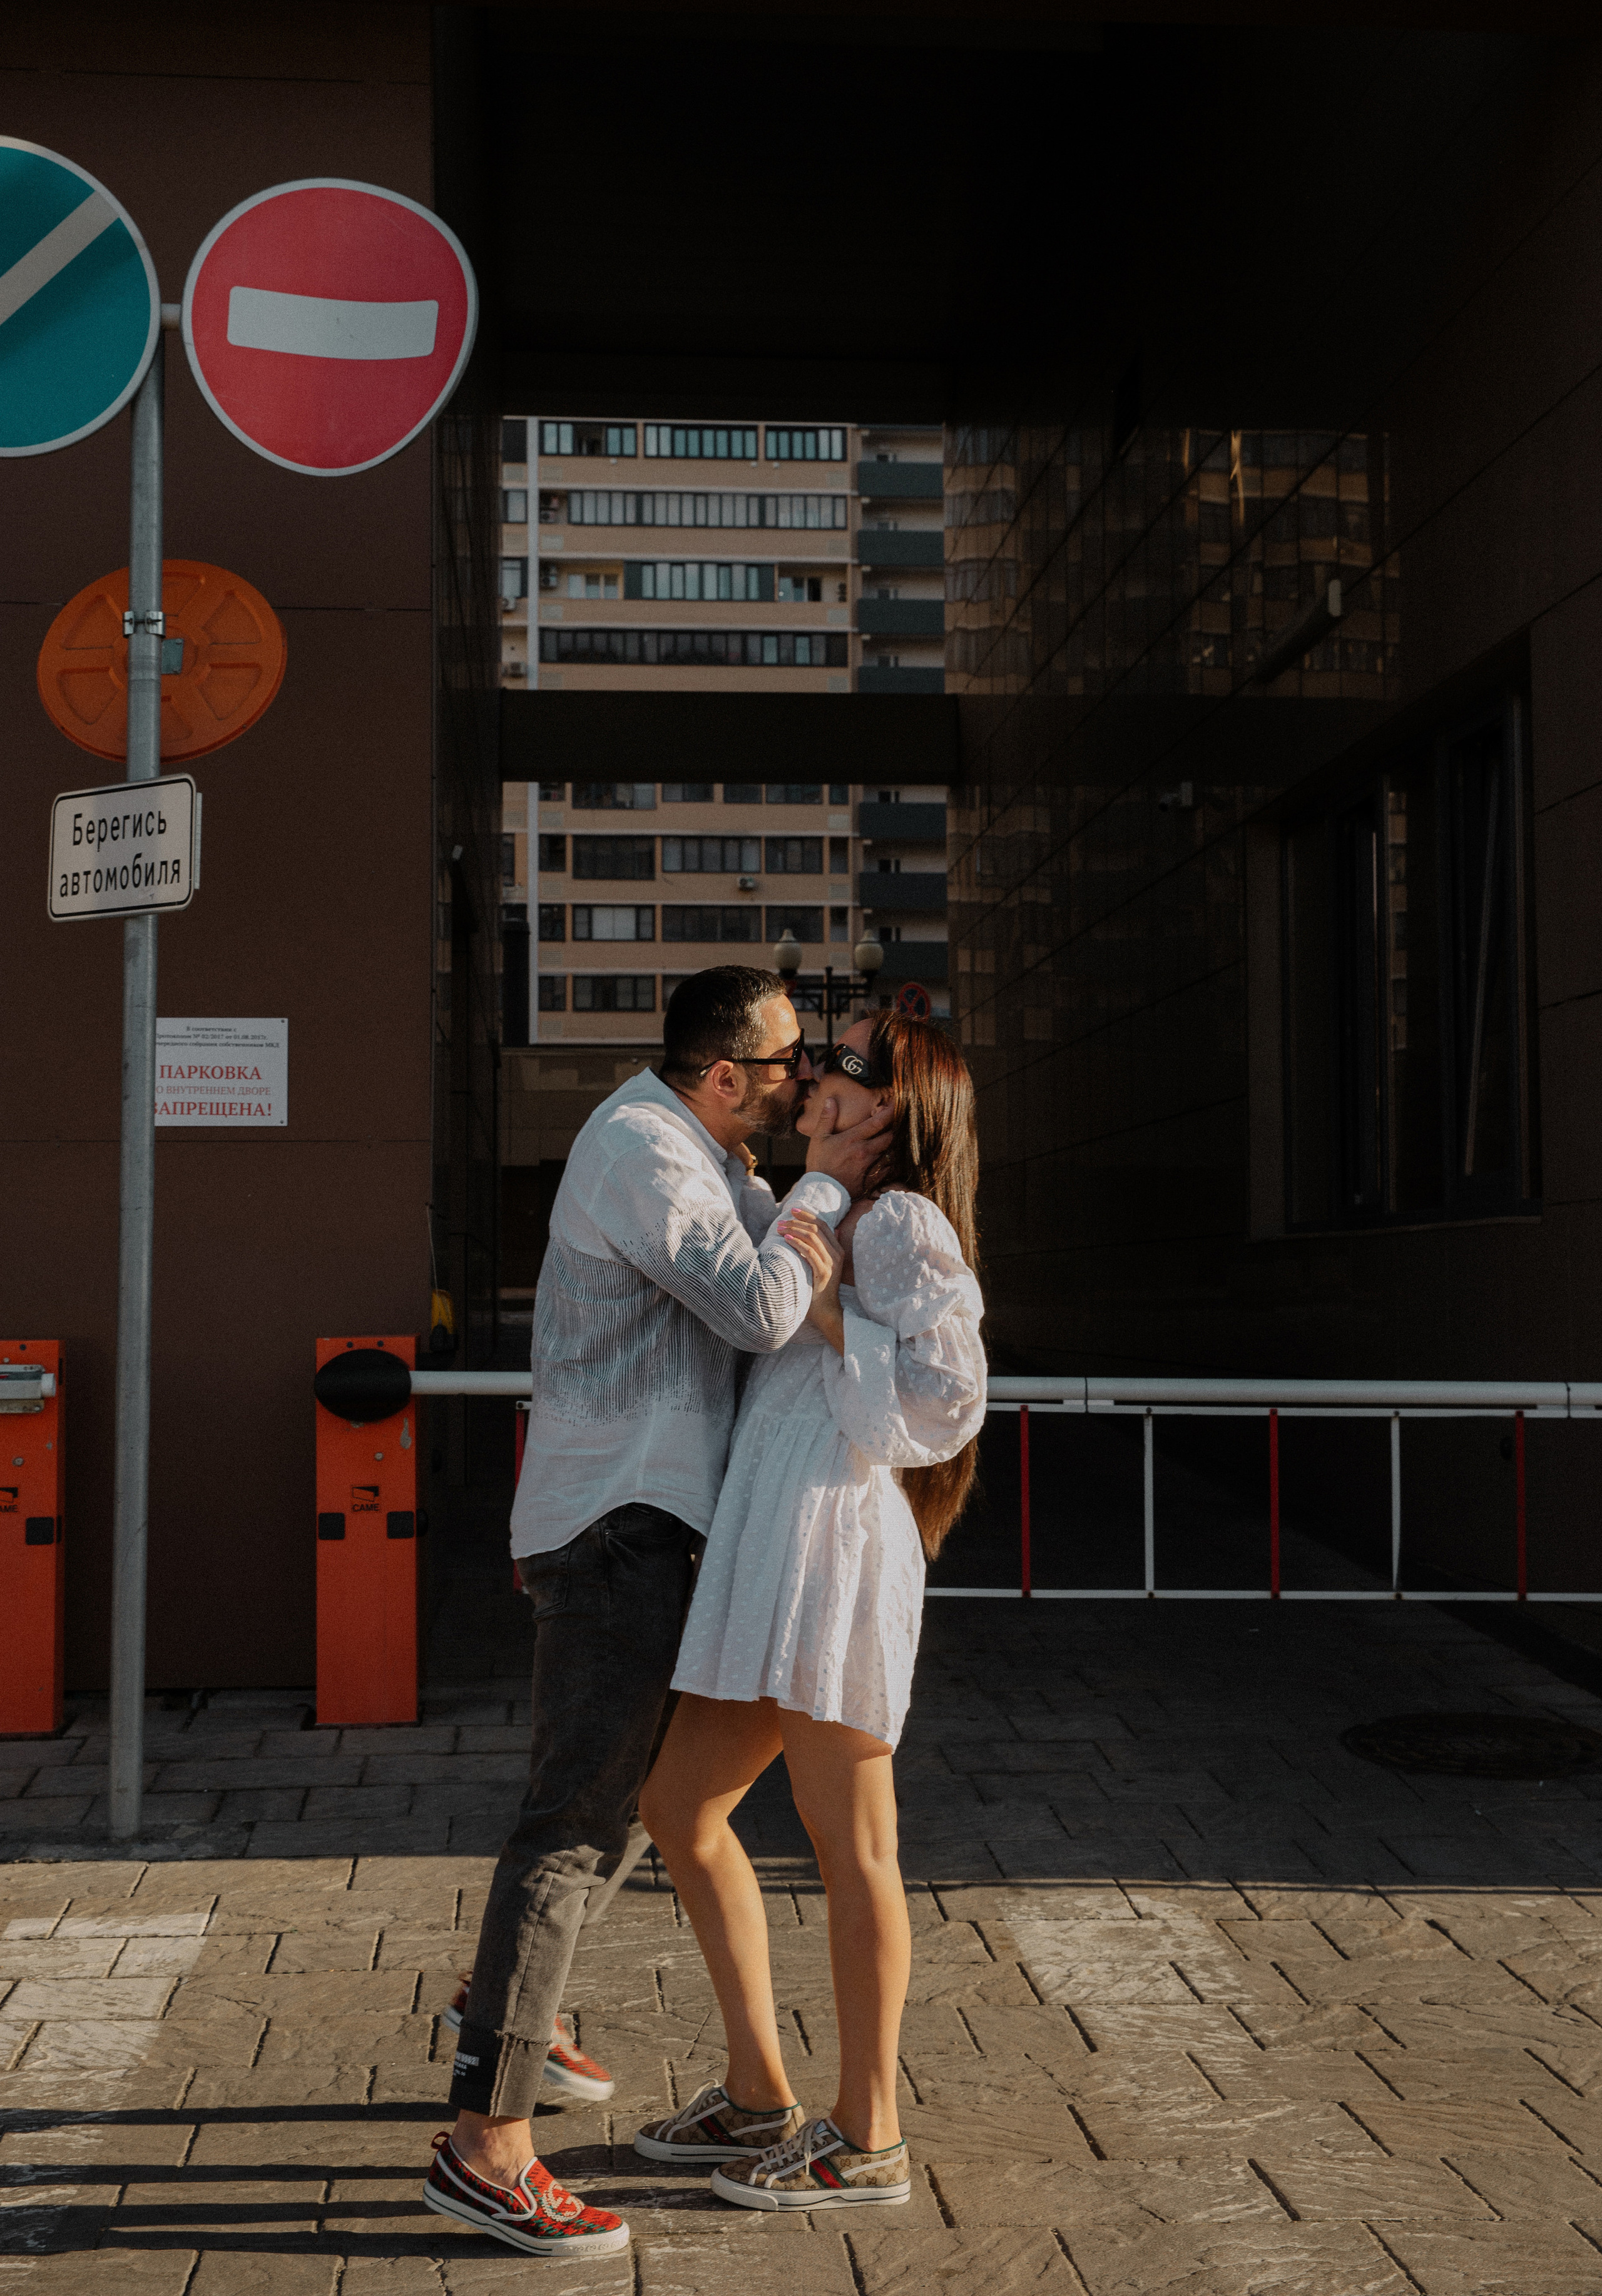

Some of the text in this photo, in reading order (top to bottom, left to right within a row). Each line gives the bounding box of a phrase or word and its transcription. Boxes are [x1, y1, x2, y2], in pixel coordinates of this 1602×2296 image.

[73, 810, 166, 852] Берегись
[60, 853, 180, 897] автомобиля
[160, 1065, 262, 1080] ПАРКОВКА
[166, 1085, 235, 1095] ВНУТРЕННЕМ
[237, 1086, 272, 1096] ДВОРЕ
[0, 1505, 18, 1513] AME
[352, 1503, 380, 1512] CAME
